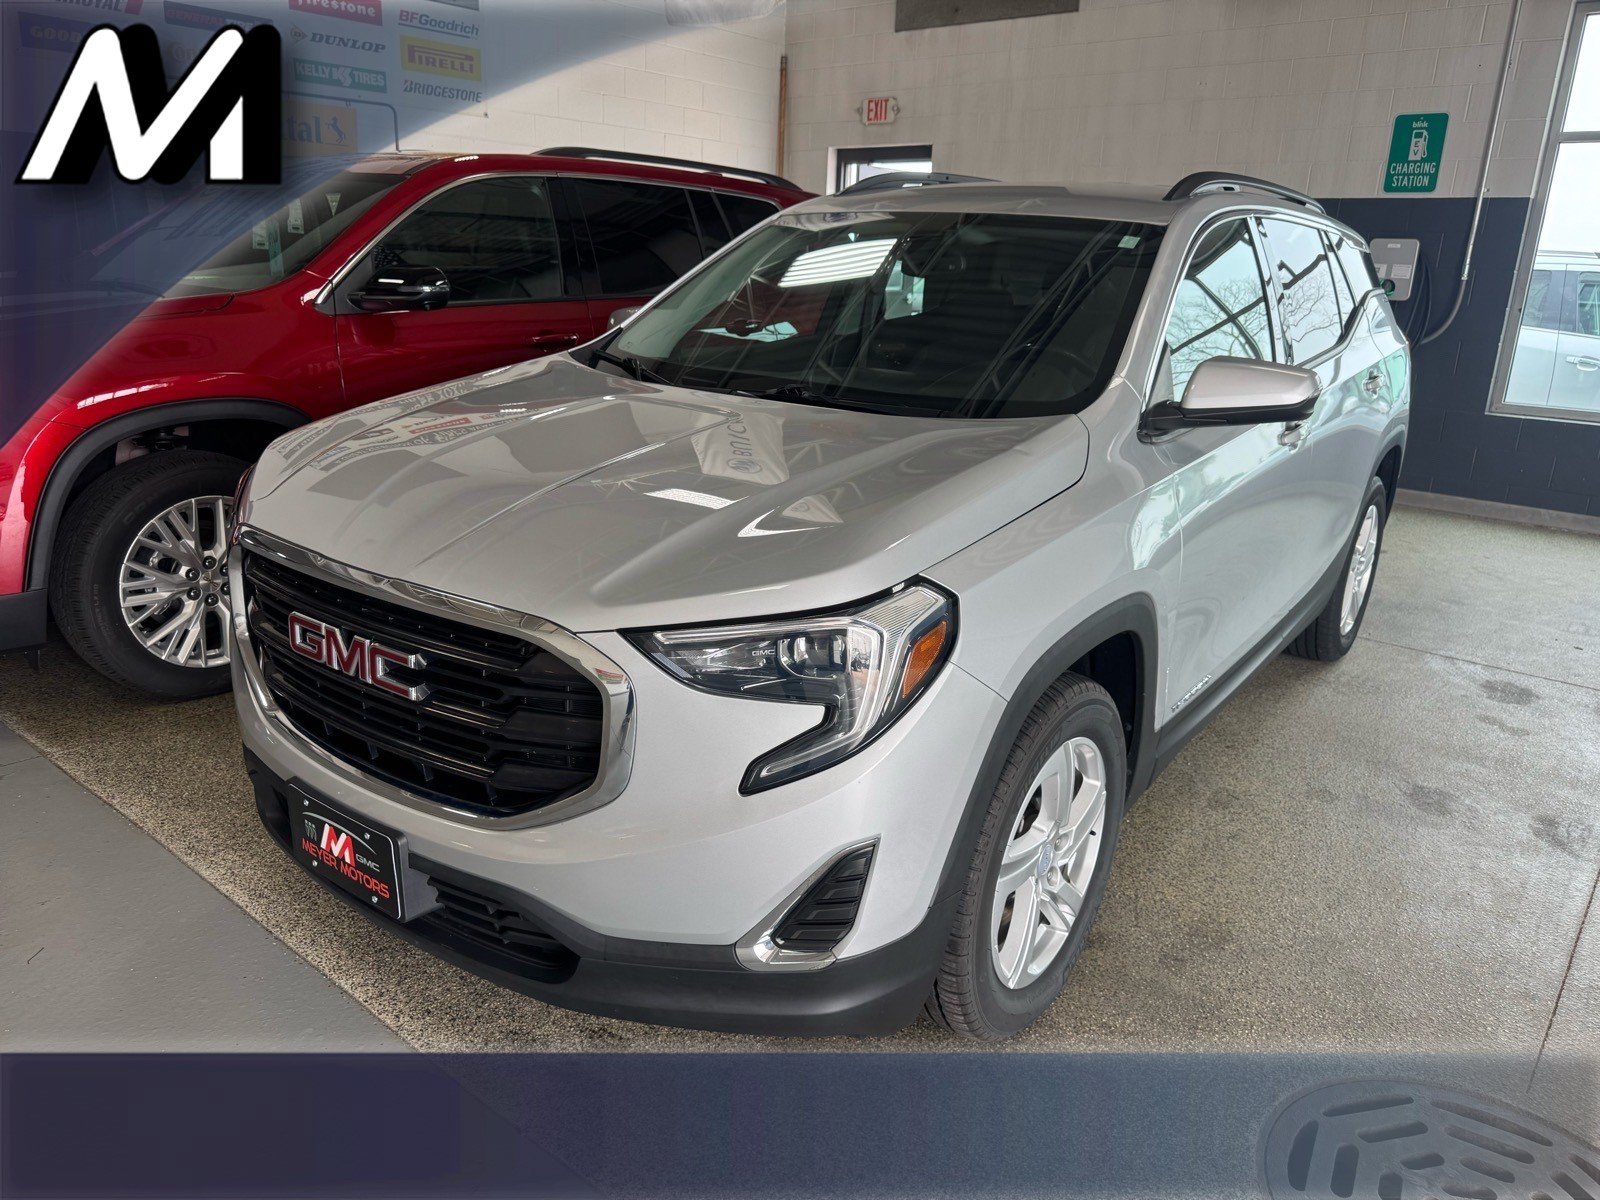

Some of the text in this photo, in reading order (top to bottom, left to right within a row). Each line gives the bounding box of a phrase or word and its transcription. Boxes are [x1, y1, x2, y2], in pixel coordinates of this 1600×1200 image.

[400, 9, 479, 36] BFGoodrich
[309, 32, 386, 53] DUNLOP
[407, 44, 474, 74] PIRELLI
[296, 62, 331, 79] KELLY
[353, 72, 385, 86] TIRES
[403, 79, 483, 103] BRIDGESTONE
[867, 99, 889, 121] EXIT
[1390, 162, 1436, 174] CHARGING
[1391, 175, 1430, 187] STATION
[288, 611, 427, 701] GMC
[752, 649, 775, 657] GMC
[302, 837, 390, 899] MEYER MOTORS
[355, 853, 380, 872] GMC
